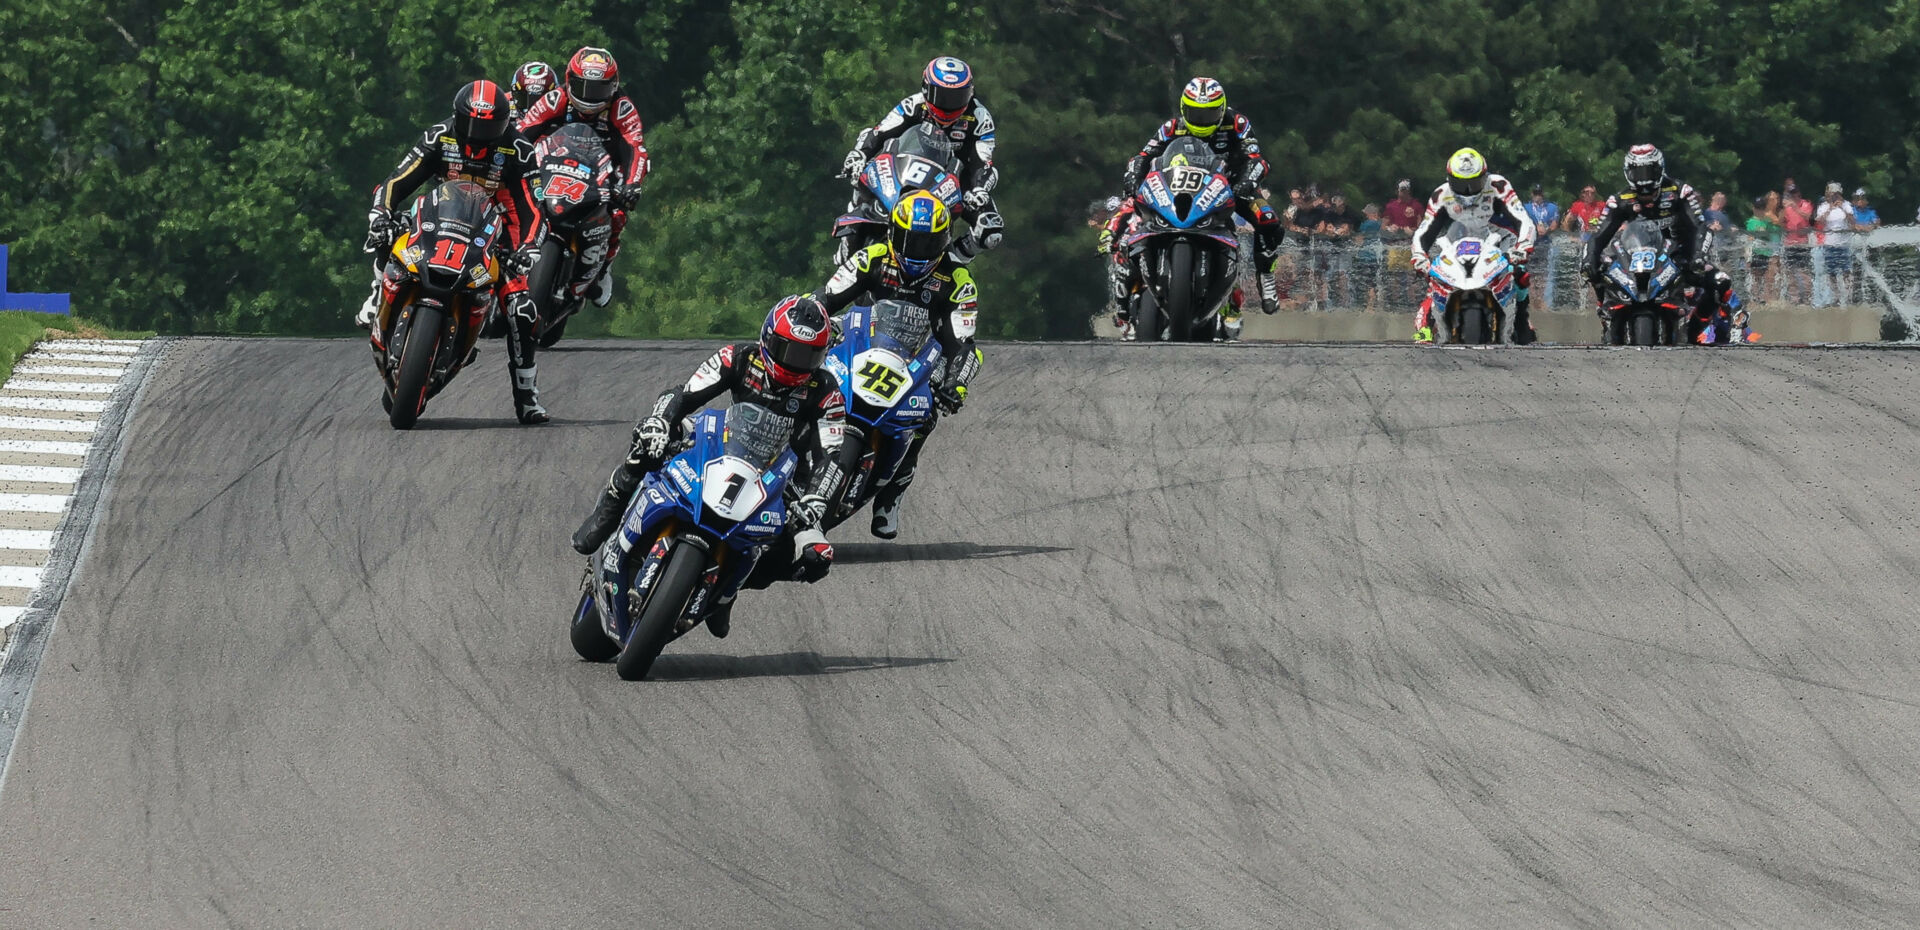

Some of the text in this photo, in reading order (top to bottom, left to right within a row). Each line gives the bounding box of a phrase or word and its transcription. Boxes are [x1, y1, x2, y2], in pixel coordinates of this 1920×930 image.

[545, 163, 590, 180] SUZUKI
[907, 161, 931, 184] 6
[1170, 170, 1202, 190] 99
[545, 175, 588, 201] 54
[1150, 175, 1172, 206] TYTLERS
[1196, 178, 1223, 206] TYTLERS
[430, 239, 466, 269] 11
[1630, 251, 1656, 272] 23
[903, 305, 929, 319] FRESH
[798, 327, 814, 338] Arai
[857, 360, 906, 400] 45
[764, 423, 770, 431] N
[765, 412, 794, 428] FRESH
[671, 467, 693, 495] YAMAHA
[719, 472, 747, 510] 1
[826, 468, 844, 500] YAMAHA
[744, 525, 776, 533] PROGRESSIVE
